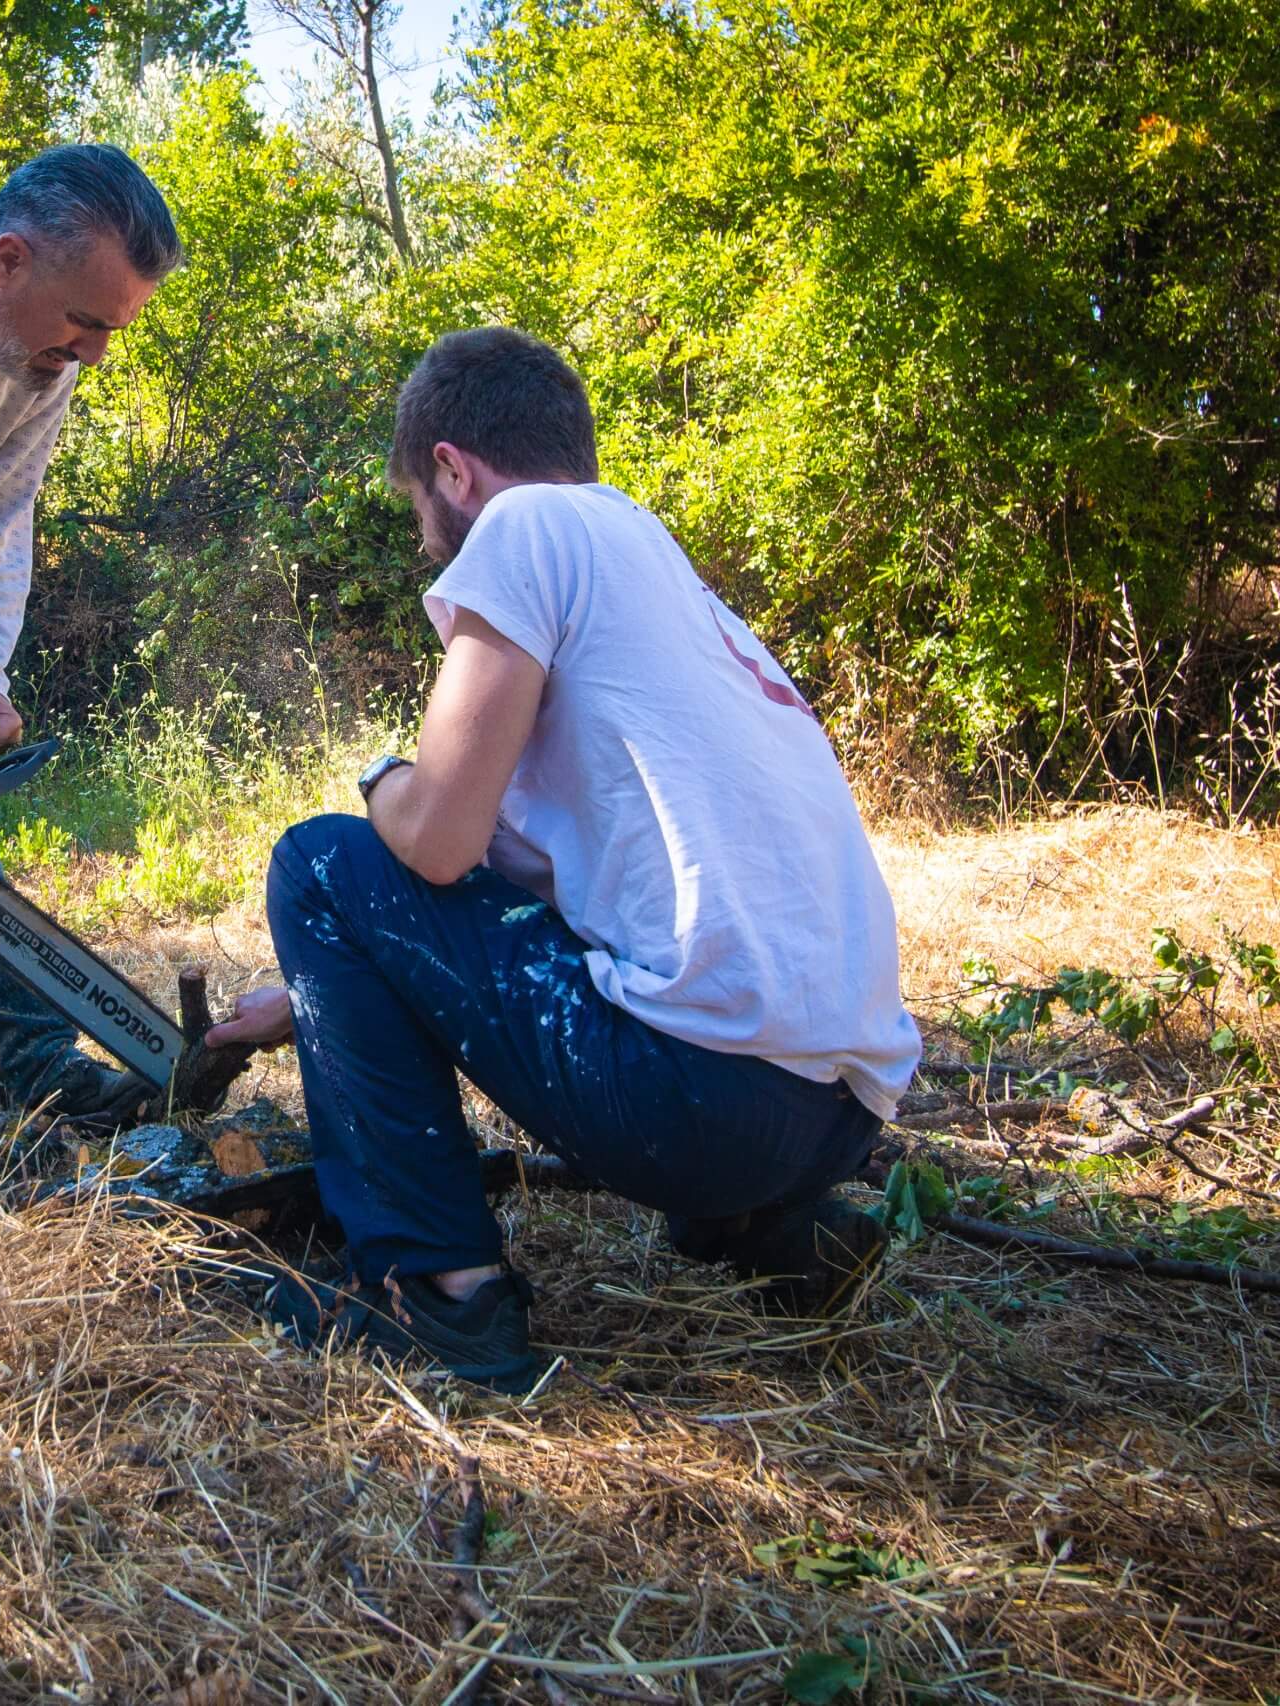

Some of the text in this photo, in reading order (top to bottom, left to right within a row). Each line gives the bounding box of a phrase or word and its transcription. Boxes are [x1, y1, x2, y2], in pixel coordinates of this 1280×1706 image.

[1, 913, 40, 948] GUARD
[39, 946, 84, 985] DOUBLE
[86, 984, 164, 1054] OREGON
